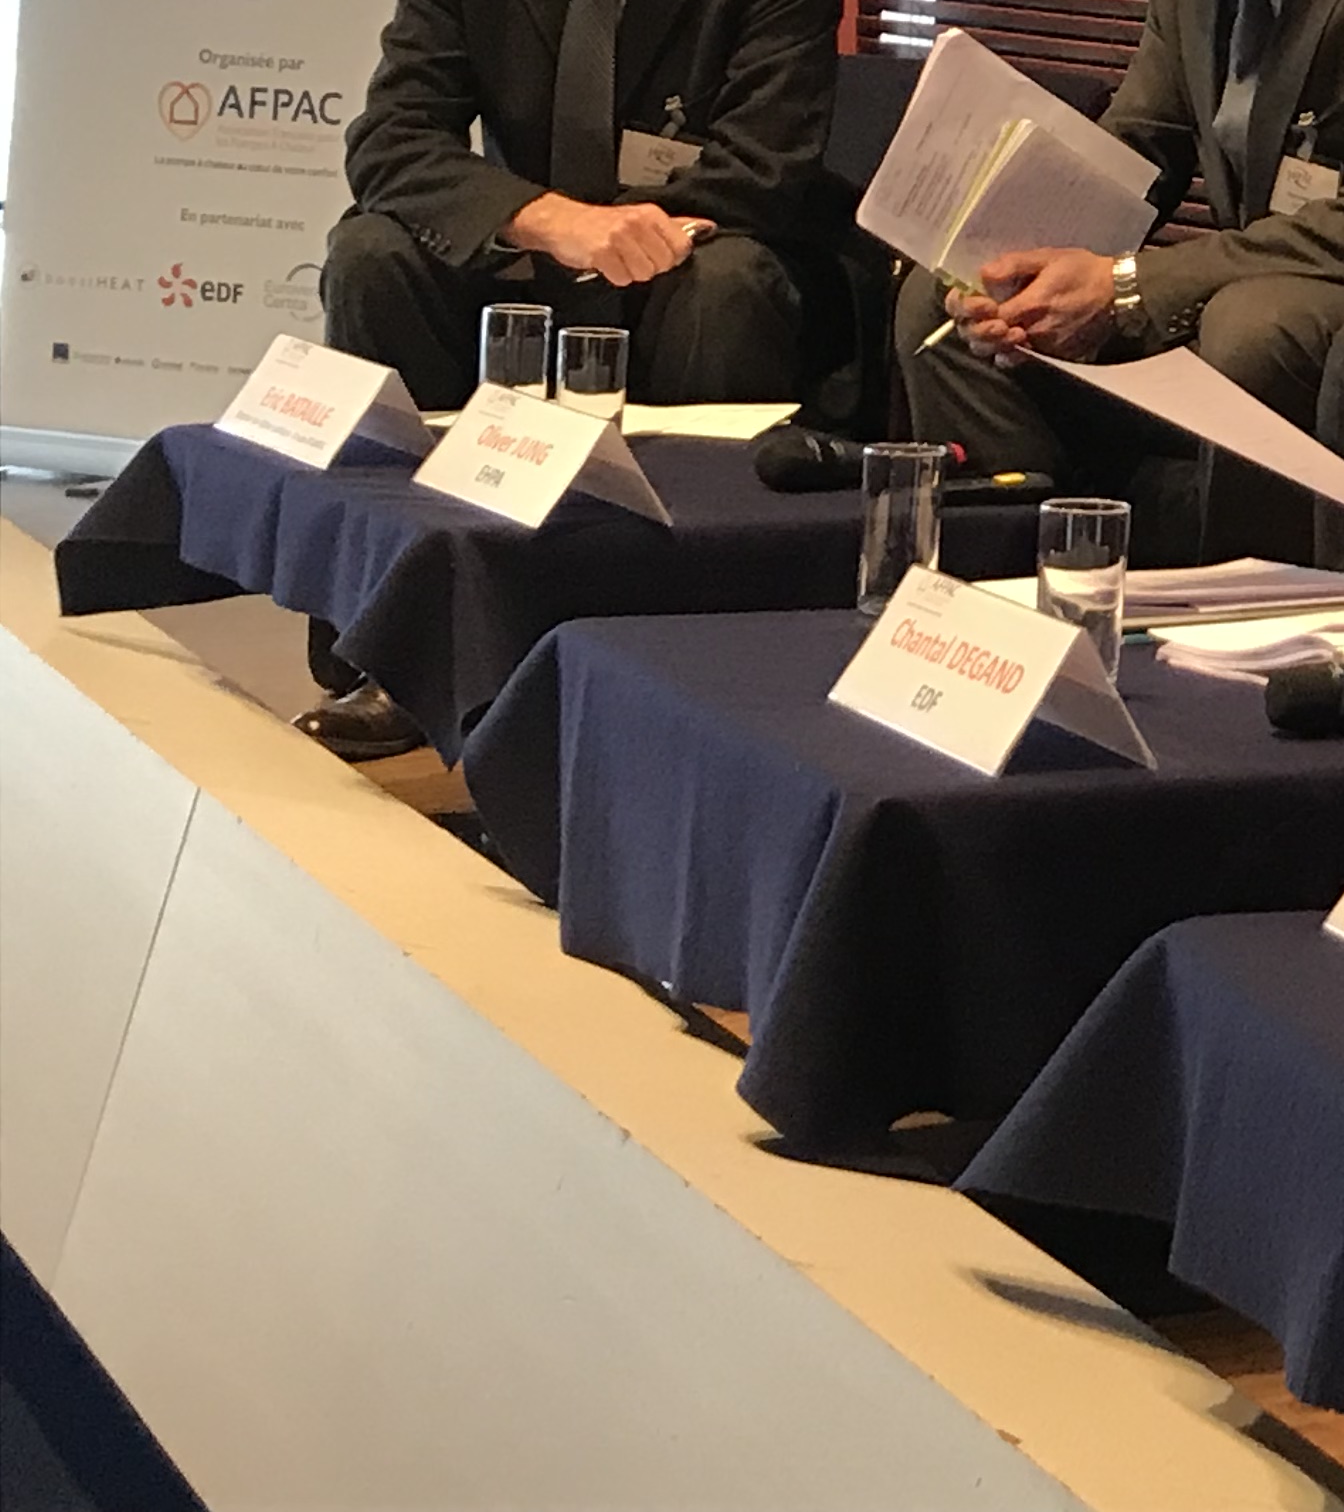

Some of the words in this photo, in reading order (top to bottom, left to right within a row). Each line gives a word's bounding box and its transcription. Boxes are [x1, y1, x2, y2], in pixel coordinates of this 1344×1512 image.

[199, 49, 274, 69] Organisée
[279, 58, 304, 71] par
[217, 85, 343, 125] AFPAC
[890, 618, 957, 665] Chantal
[911, 684, 943, 712] EDF
